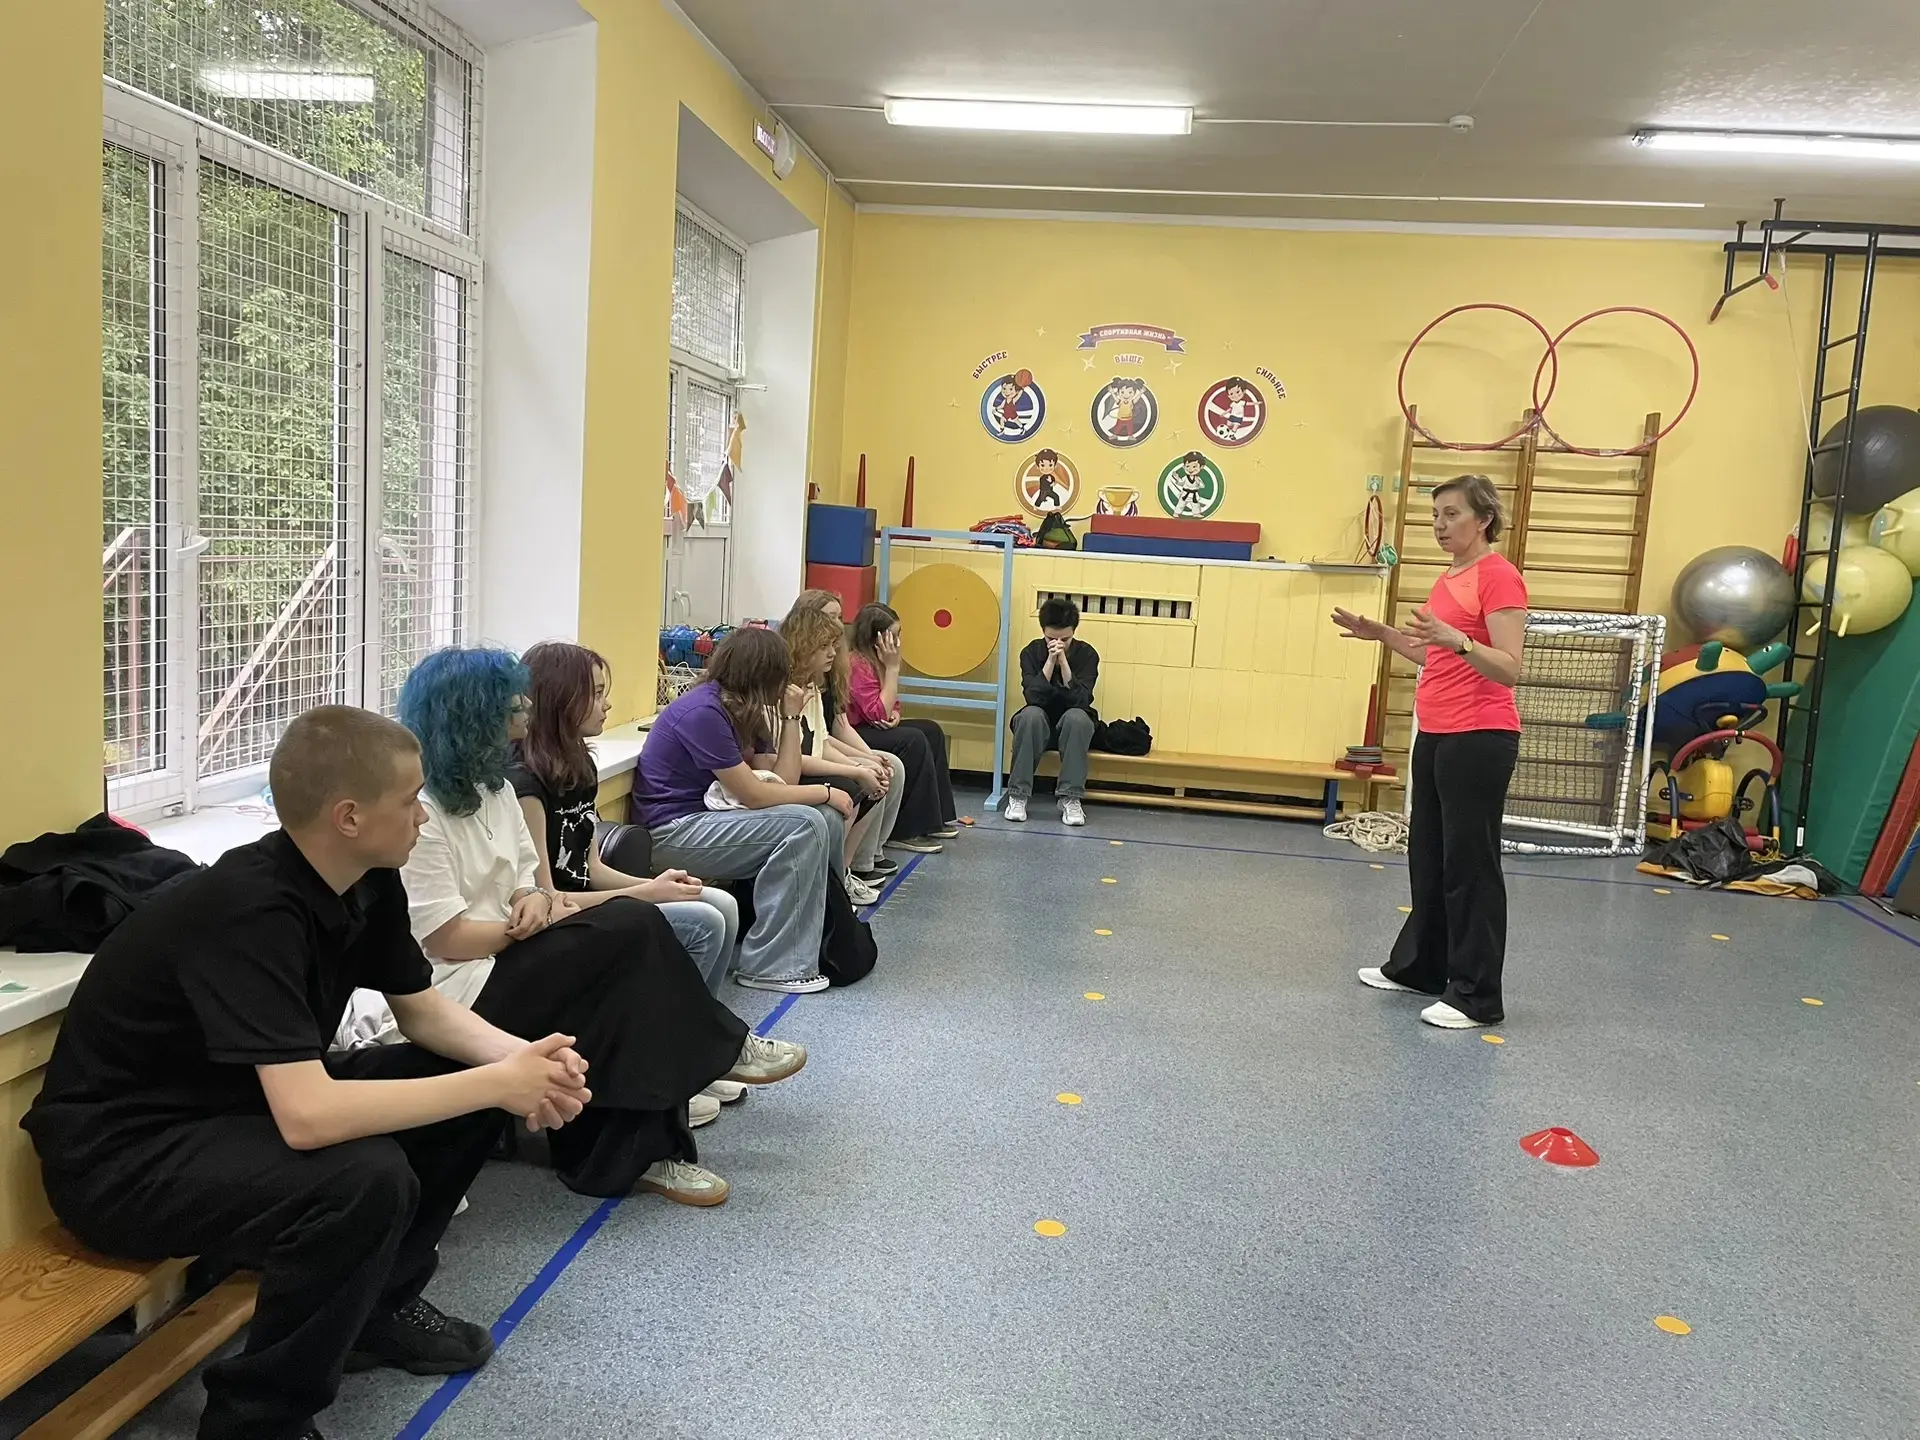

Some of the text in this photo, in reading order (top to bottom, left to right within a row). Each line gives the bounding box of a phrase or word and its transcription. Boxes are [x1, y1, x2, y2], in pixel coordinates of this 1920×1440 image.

[1099, 328, 1167, 340] СПОРТИВНАЯ ЖИЗНЬ
[972, 350, 1007, 379] БЫСТРЕЕ
[1114, 354, 1143, 364] ВЫШЕ
[1255, 366, 1286, 399] СИЛЬНЕЕ
